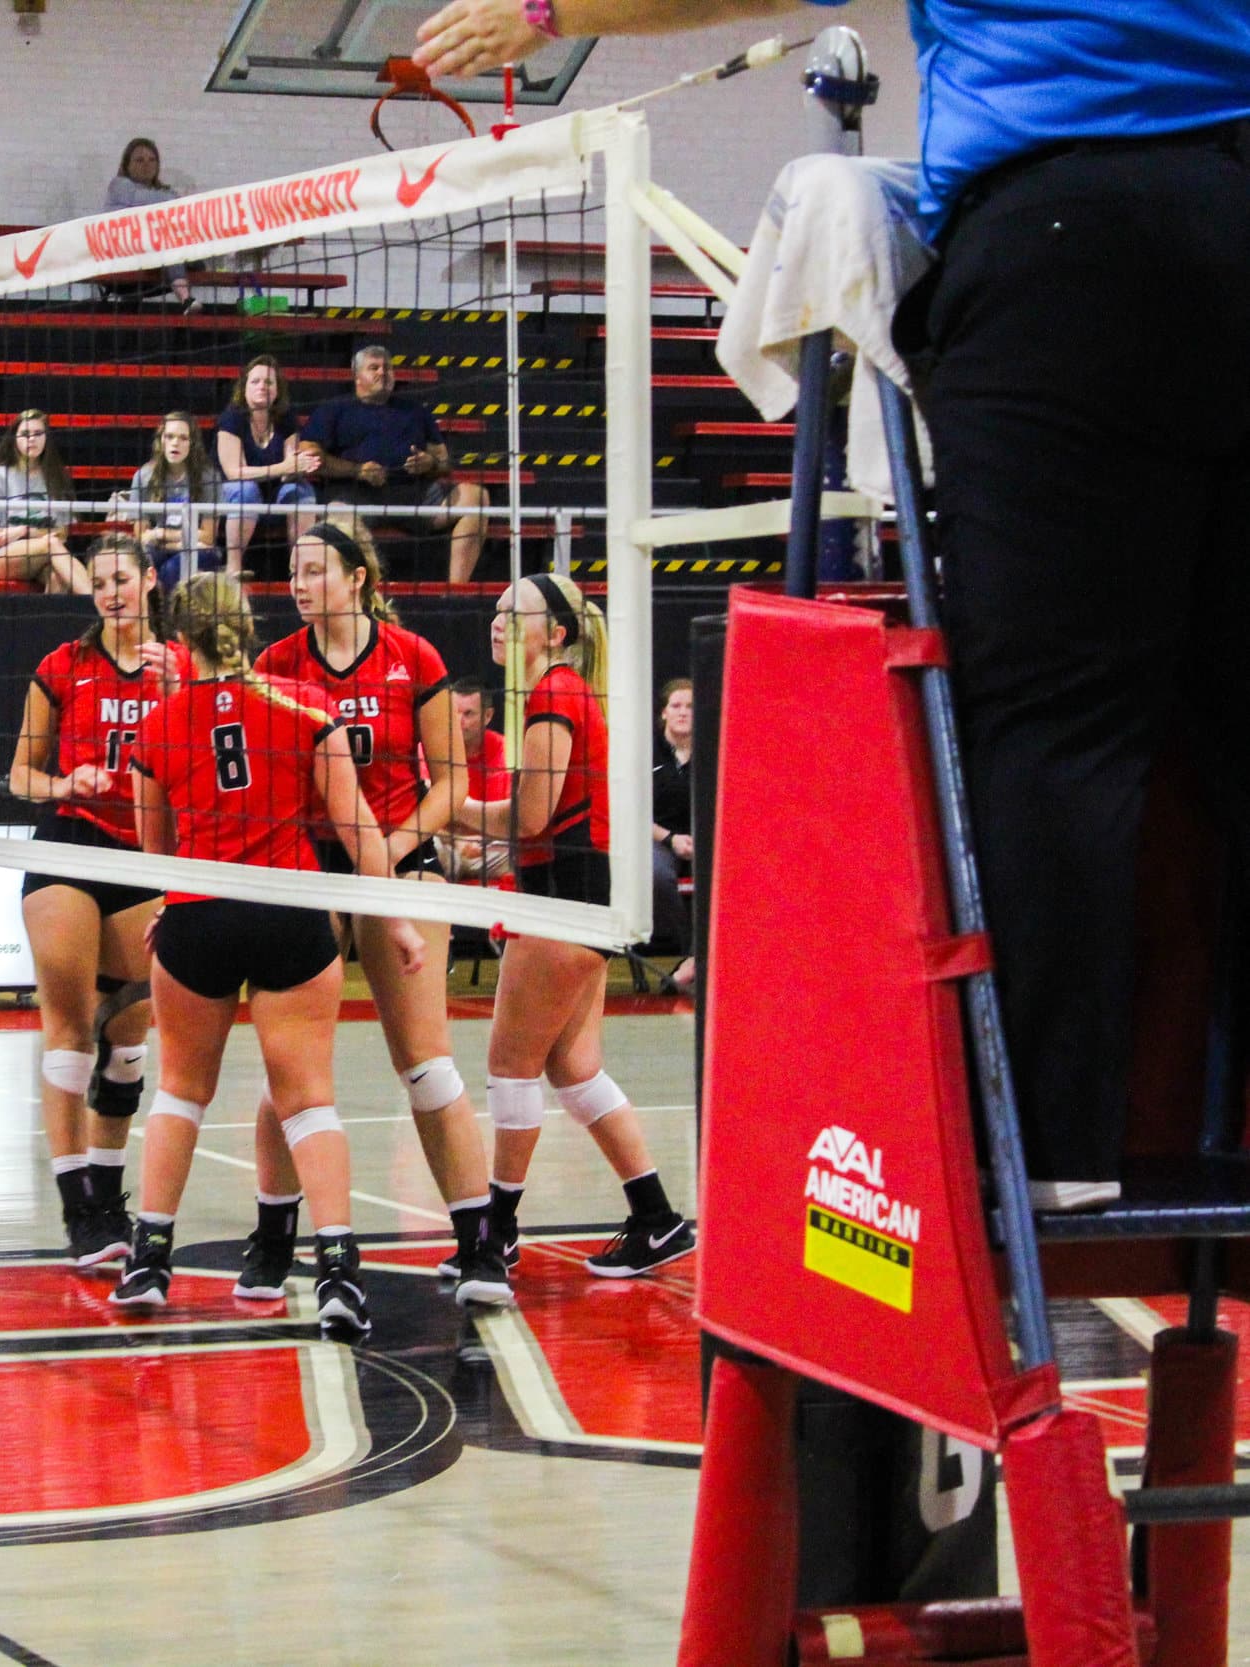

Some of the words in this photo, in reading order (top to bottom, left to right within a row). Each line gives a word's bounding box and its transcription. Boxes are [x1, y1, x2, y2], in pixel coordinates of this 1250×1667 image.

[85, 216, 146, 261] NORTH
[146, 193, 249, 252] GREENVILLE
[248, 168, 360, 232] UNIVERSITY
[211, 722, 251, 792] 8
[804, 1166, 920, 1243] AMERICAN
